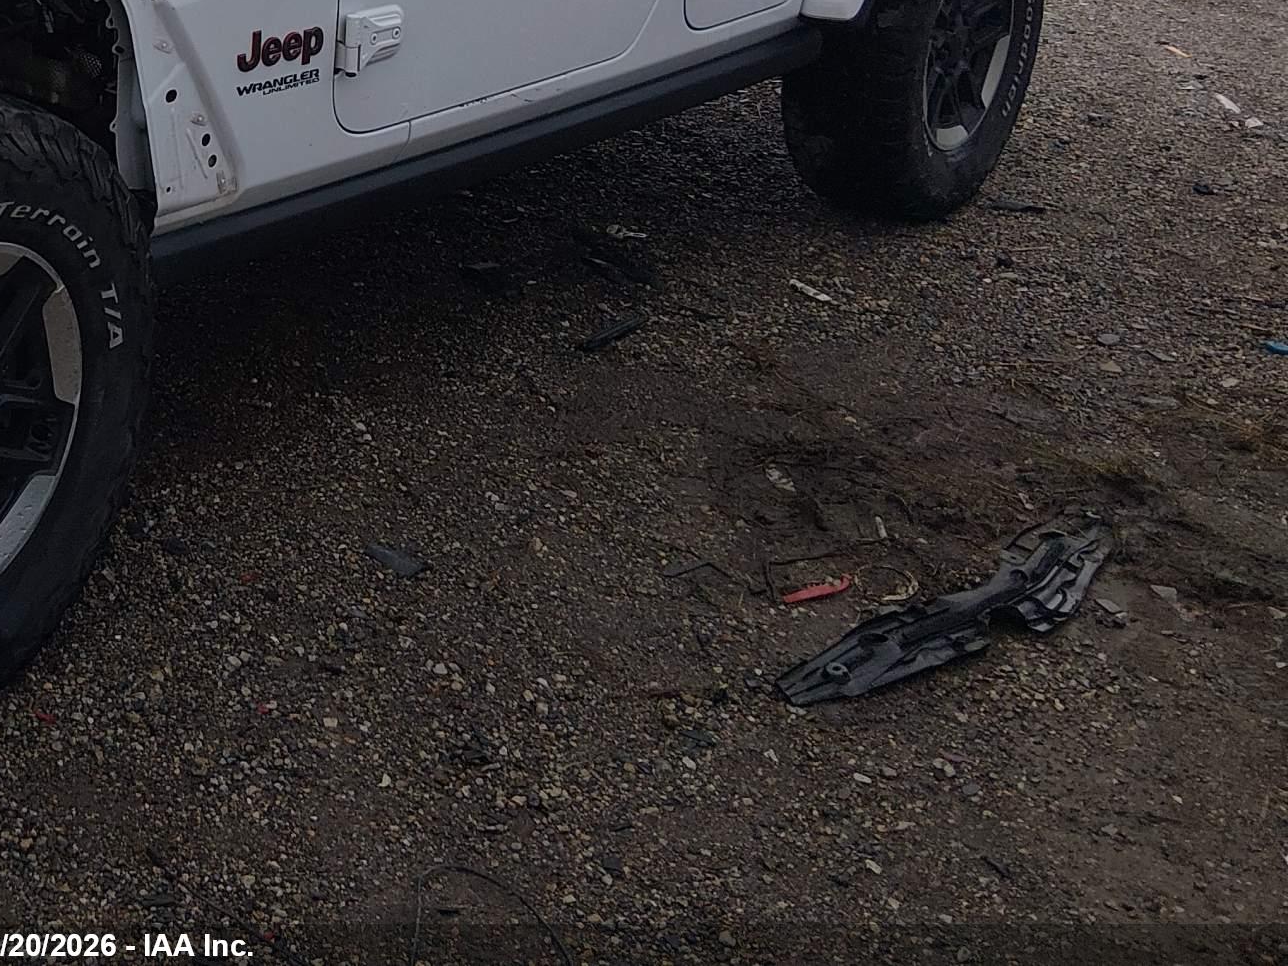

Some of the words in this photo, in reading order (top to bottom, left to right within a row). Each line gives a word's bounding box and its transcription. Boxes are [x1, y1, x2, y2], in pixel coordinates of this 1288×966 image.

[236, 26, 324, 72] Jeep
[236, 68, 320, 97] WRANGLER
[262, 77, 320, 96] UNLIMITED
[99, 282, 125, 350] T/A
